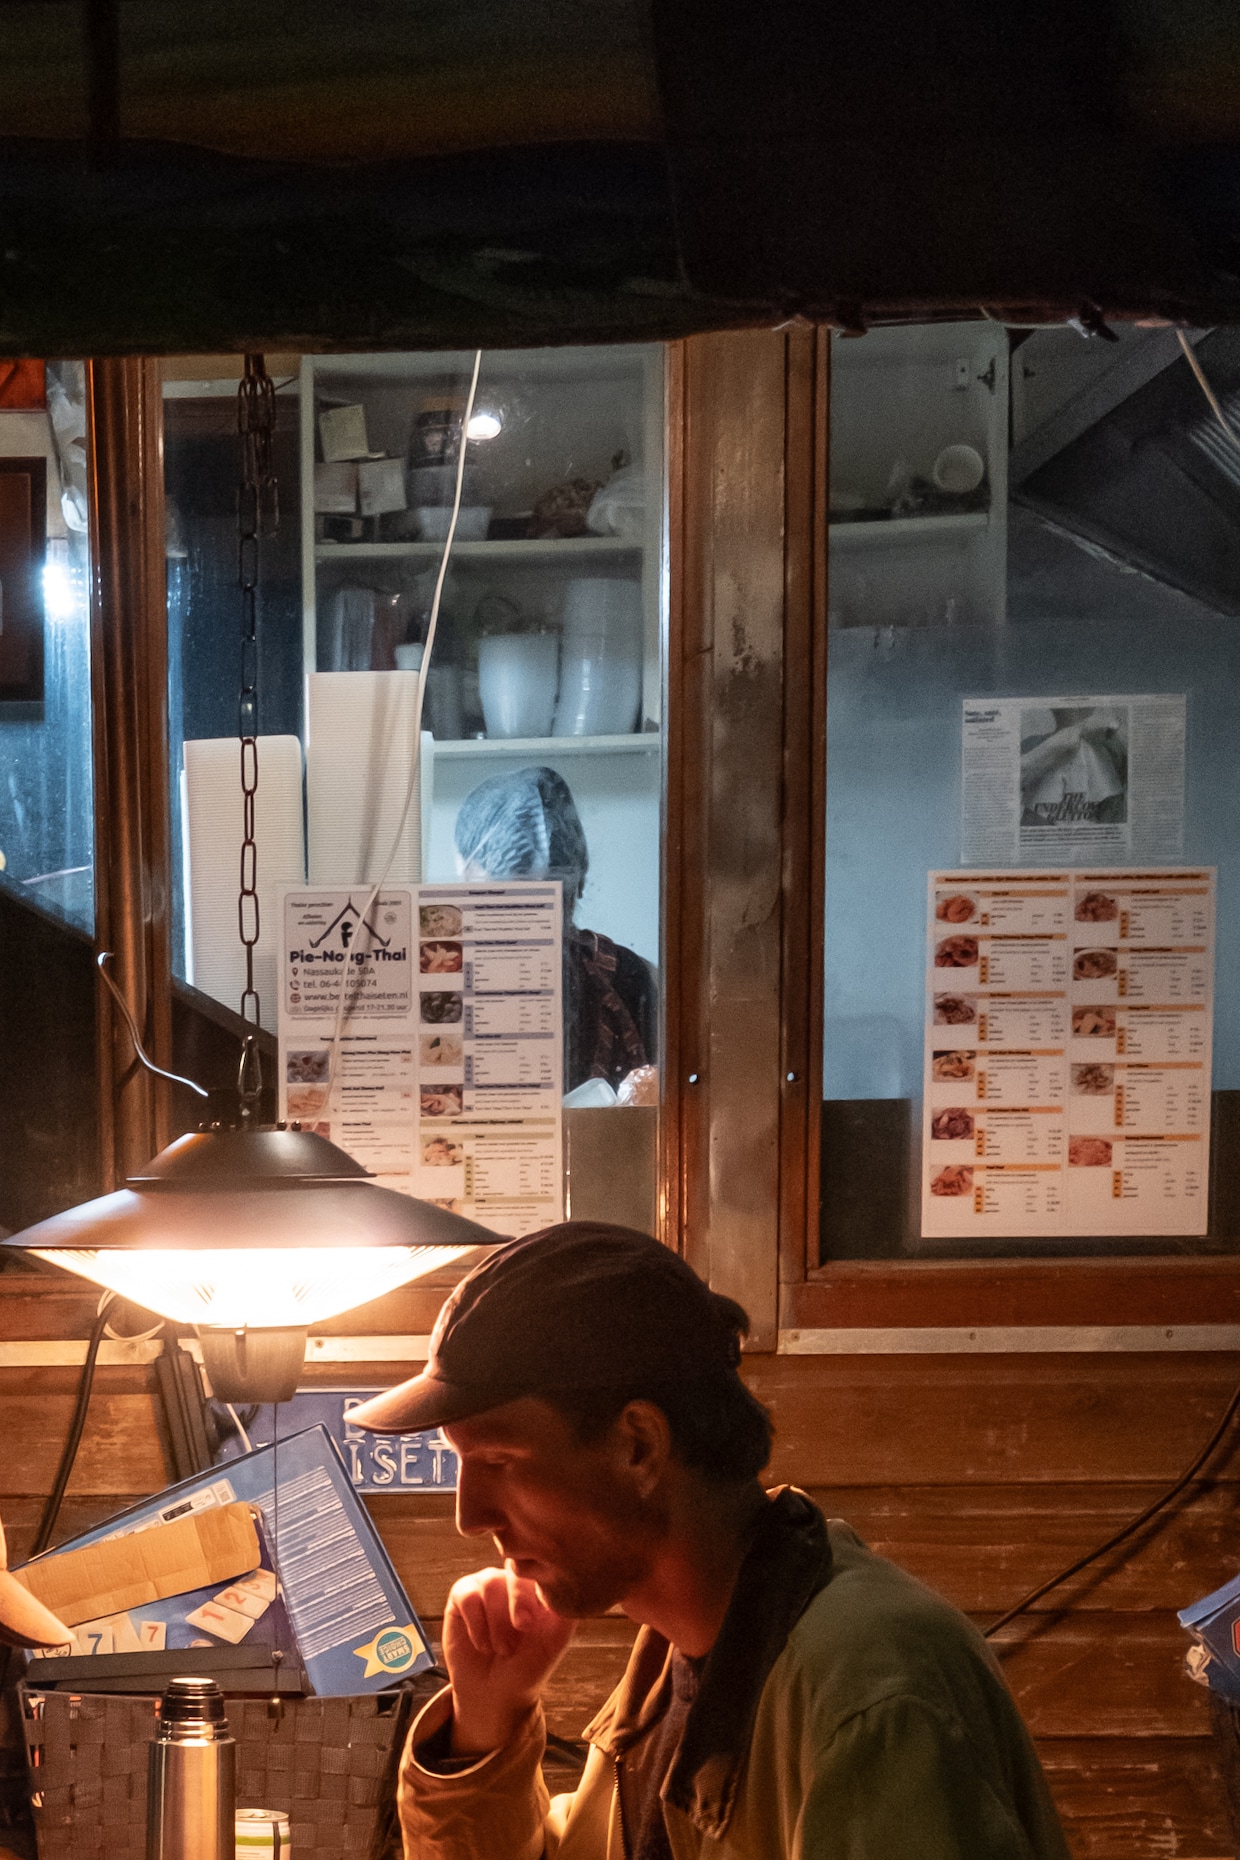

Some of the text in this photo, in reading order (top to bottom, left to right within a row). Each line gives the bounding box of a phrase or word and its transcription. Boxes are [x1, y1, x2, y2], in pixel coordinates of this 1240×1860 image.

[320, 979, 377, 988] 06-4105074
[224, 1592, 247, 1604] 2
[147, 1626, 159, 1642] 7
[87, 1633, 103, 1655] 7
